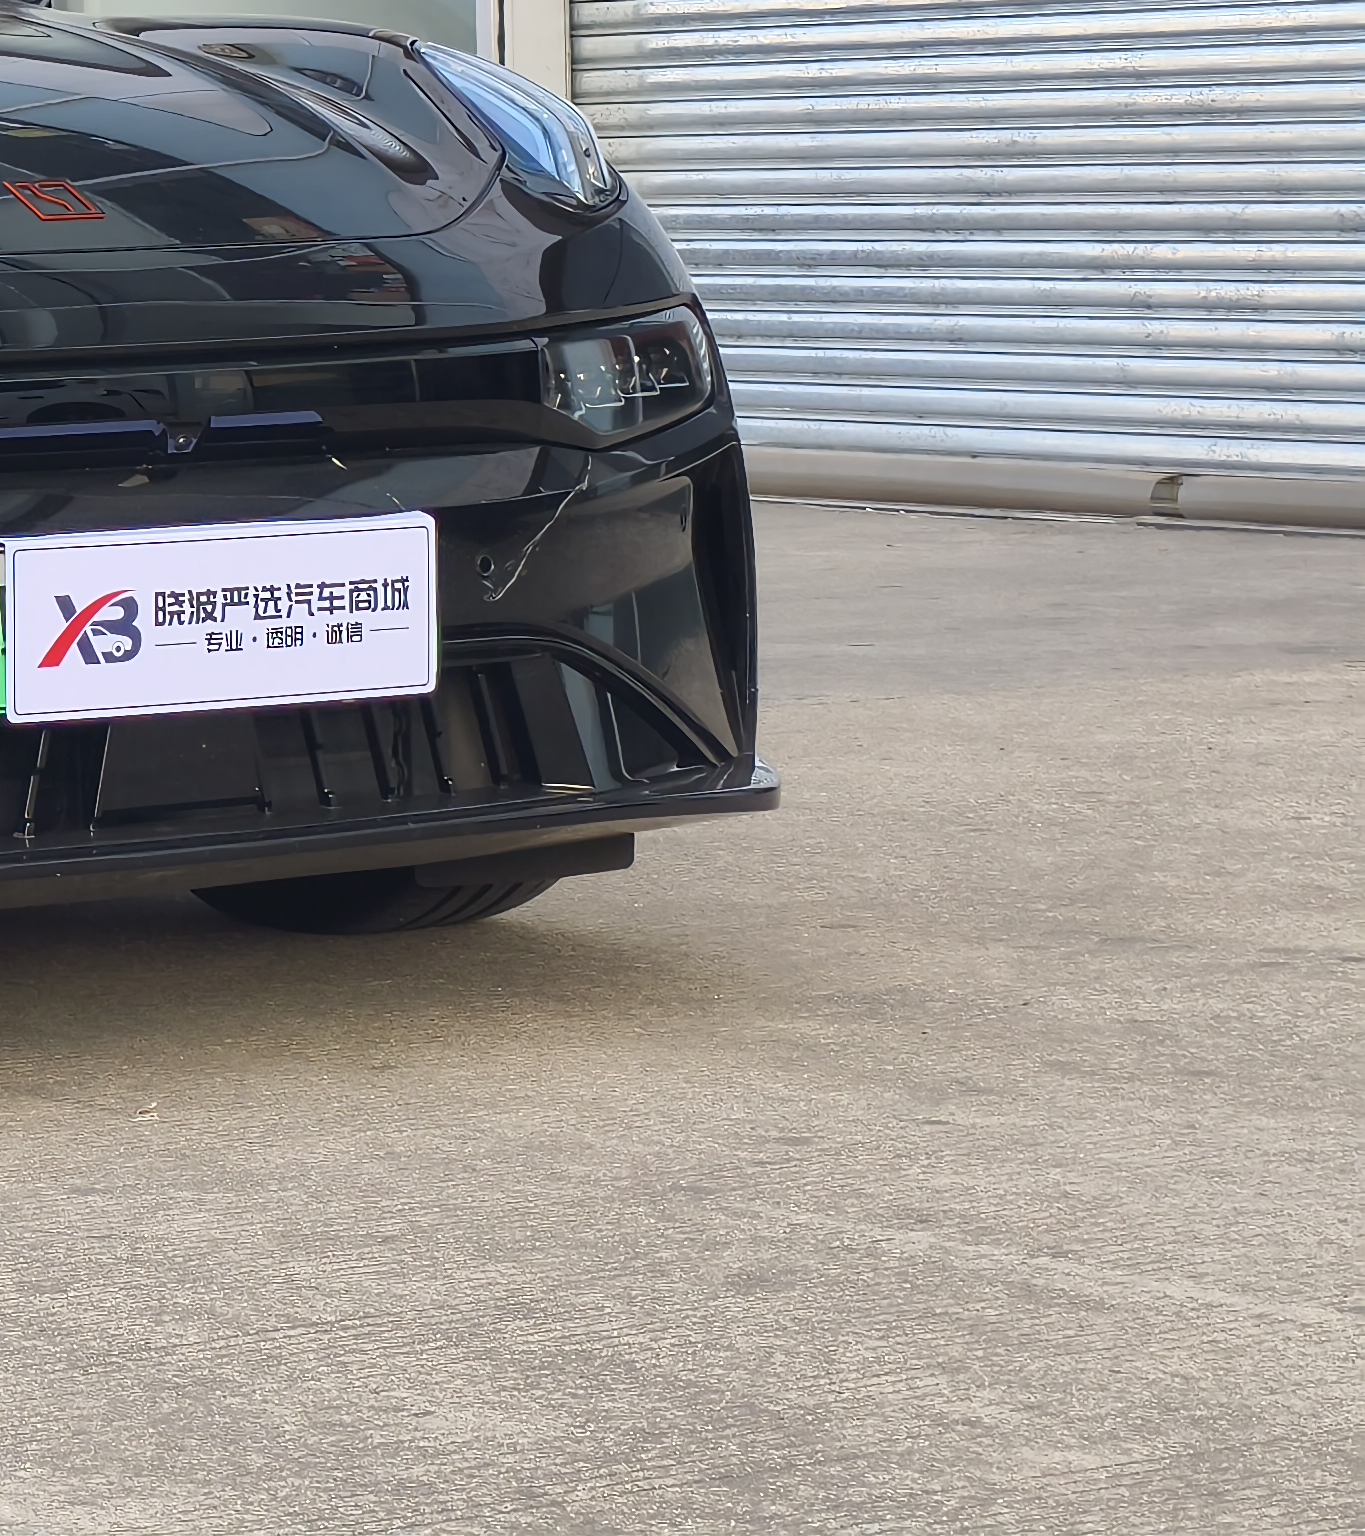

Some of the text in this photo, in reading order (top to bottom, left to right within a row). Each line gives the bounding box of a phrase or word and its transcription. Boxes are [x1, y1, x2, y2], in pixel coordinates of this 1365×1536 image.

[154, 575, 410, 627] 晓波严选汽车商城
